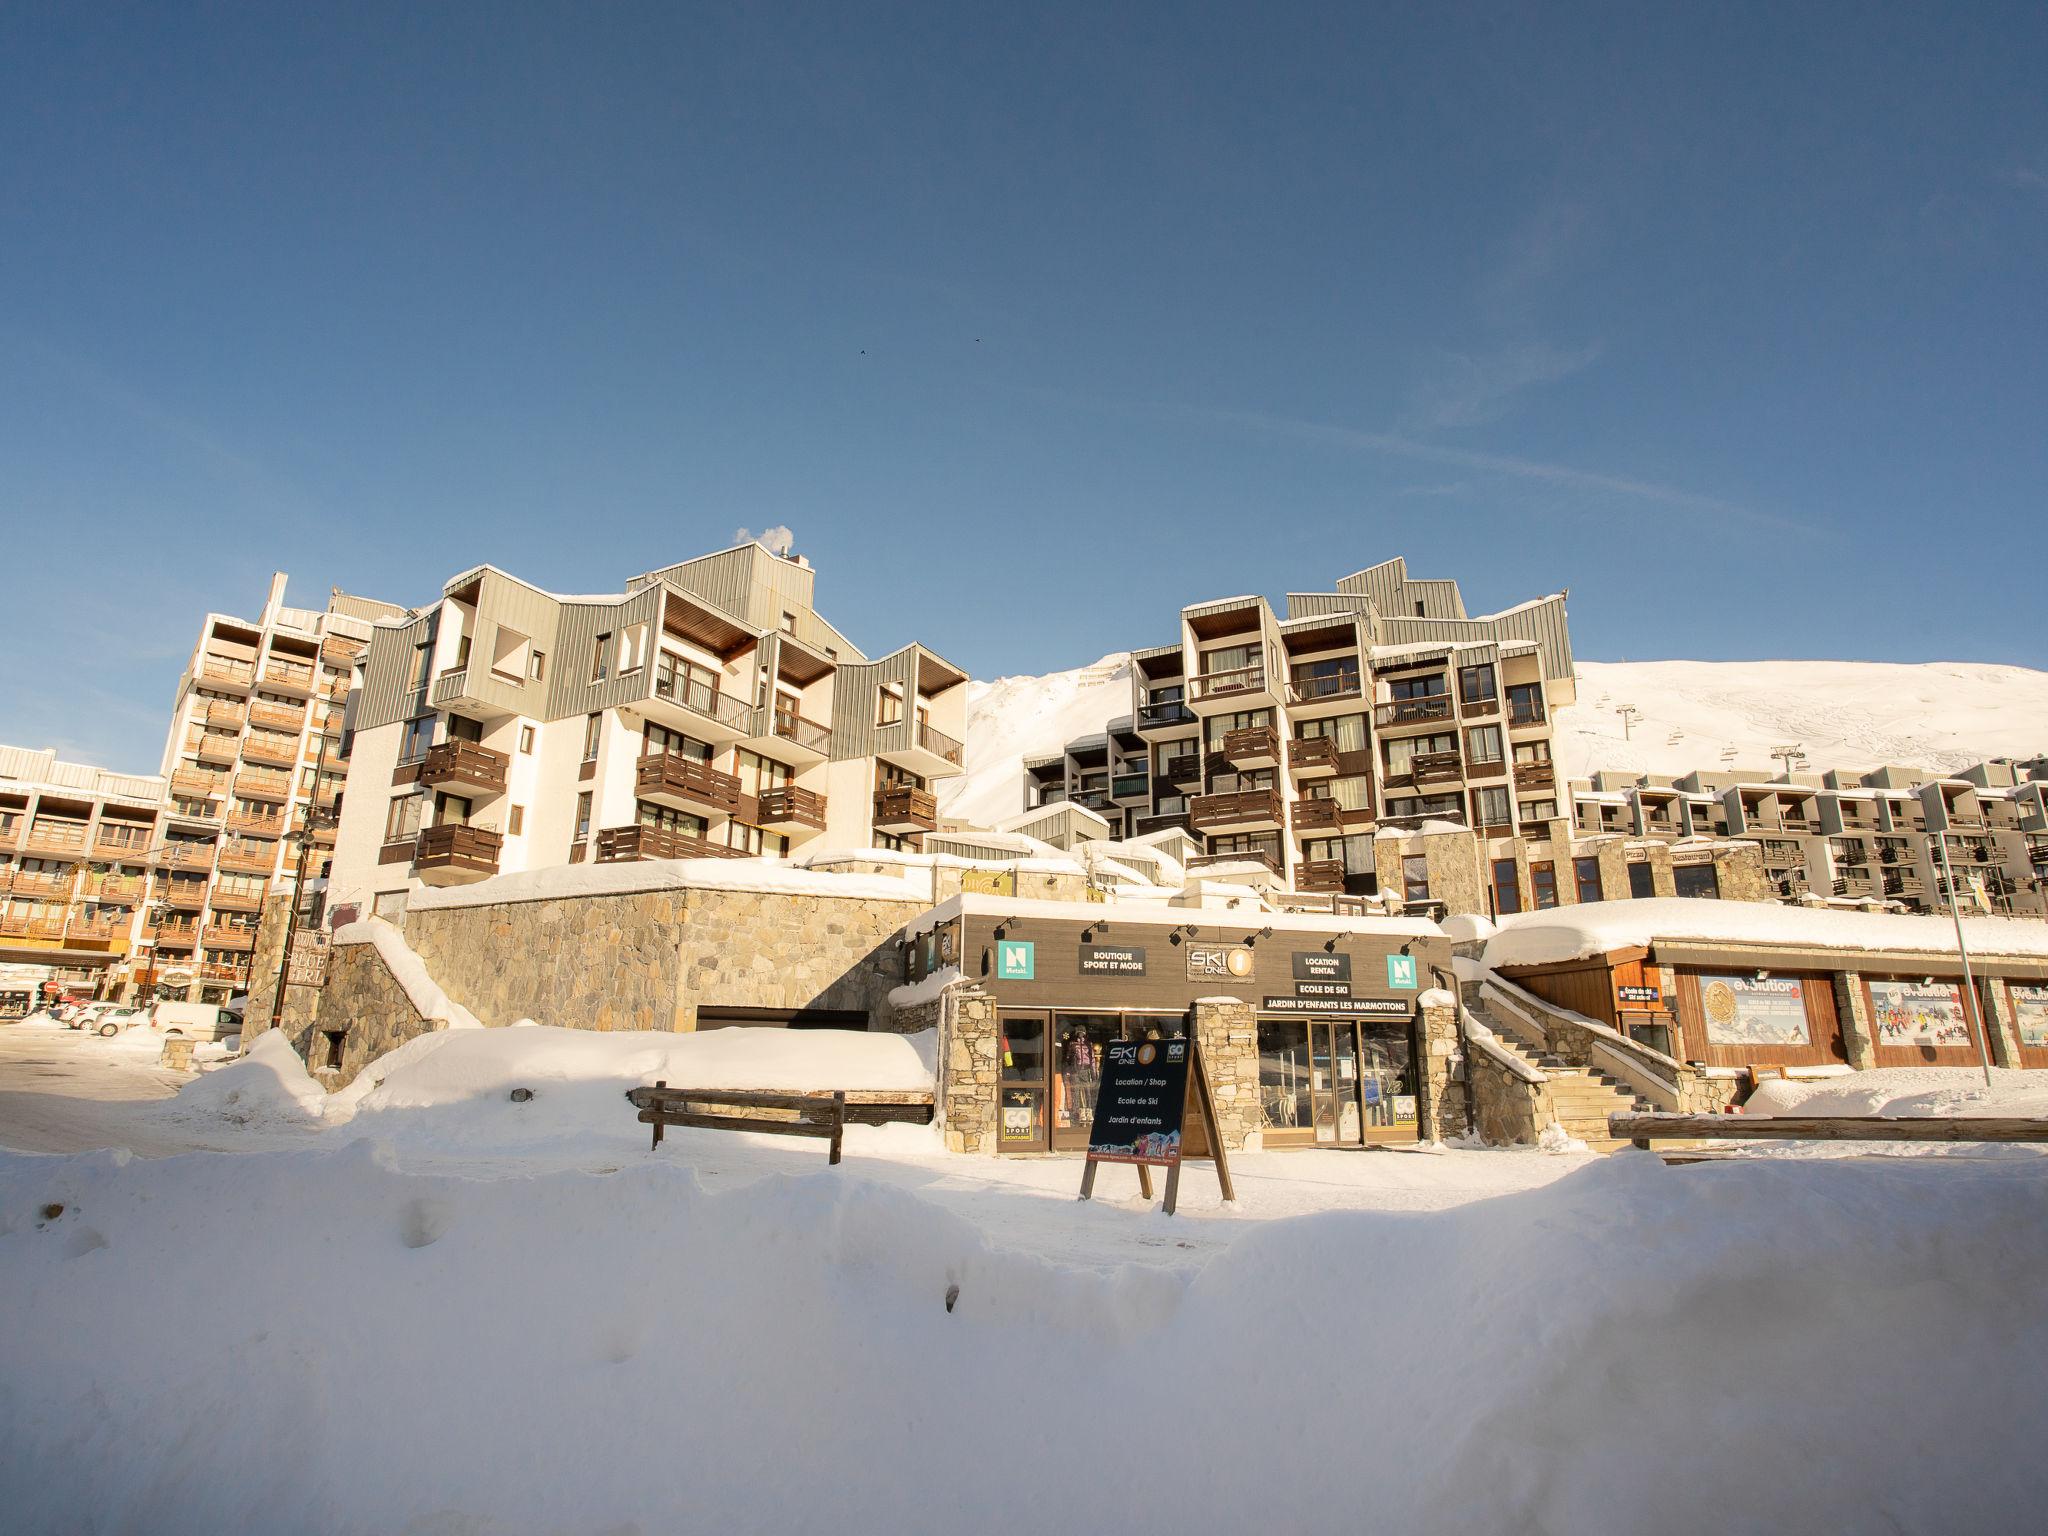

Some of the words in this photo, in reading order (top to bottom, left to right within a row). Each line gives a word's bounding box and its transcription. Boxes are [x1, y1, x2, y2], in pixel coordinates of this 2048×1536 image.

[1093, 952, 1133, 960] BOUTIQUE
[1191, 952, 1226, 967] SKI
[1120, 962, 1143, 970] MODE
[1305, 958, 1339, 966] LOCATION
[1310, 967, 1335, 975] RENTAL
[1300, 985, 1323, 993] ECOLE
[1336, 986, 1348, 994] SKI
[1267, 1000, 1296, 1009] JARDIN
[1298, 1000, 1338, 1009] D'ENFANTS
[1340, 1001, 1352, 1009] LES
[1354, 1002, 1406, 1011] MARMOTTONS
[1109, 1047, 1136, 1059] SKI
[1169, 1044, 1183, 1055] GO
[1115, 1078, 1143, 1086] Location
[1149, 1078, 1166, 1087] Shop
[1117, 1097, 1136, 1105] Ecole
[1137, 1097, 1147, 1105] de
[1148, 1097, 1158, 1105] Ski
[1006, 1111, 1030, 1128] GO
[1108, 1116, 1129, 1124] Jardin
[1130, 1116, 1162, 1125] d'enfants
